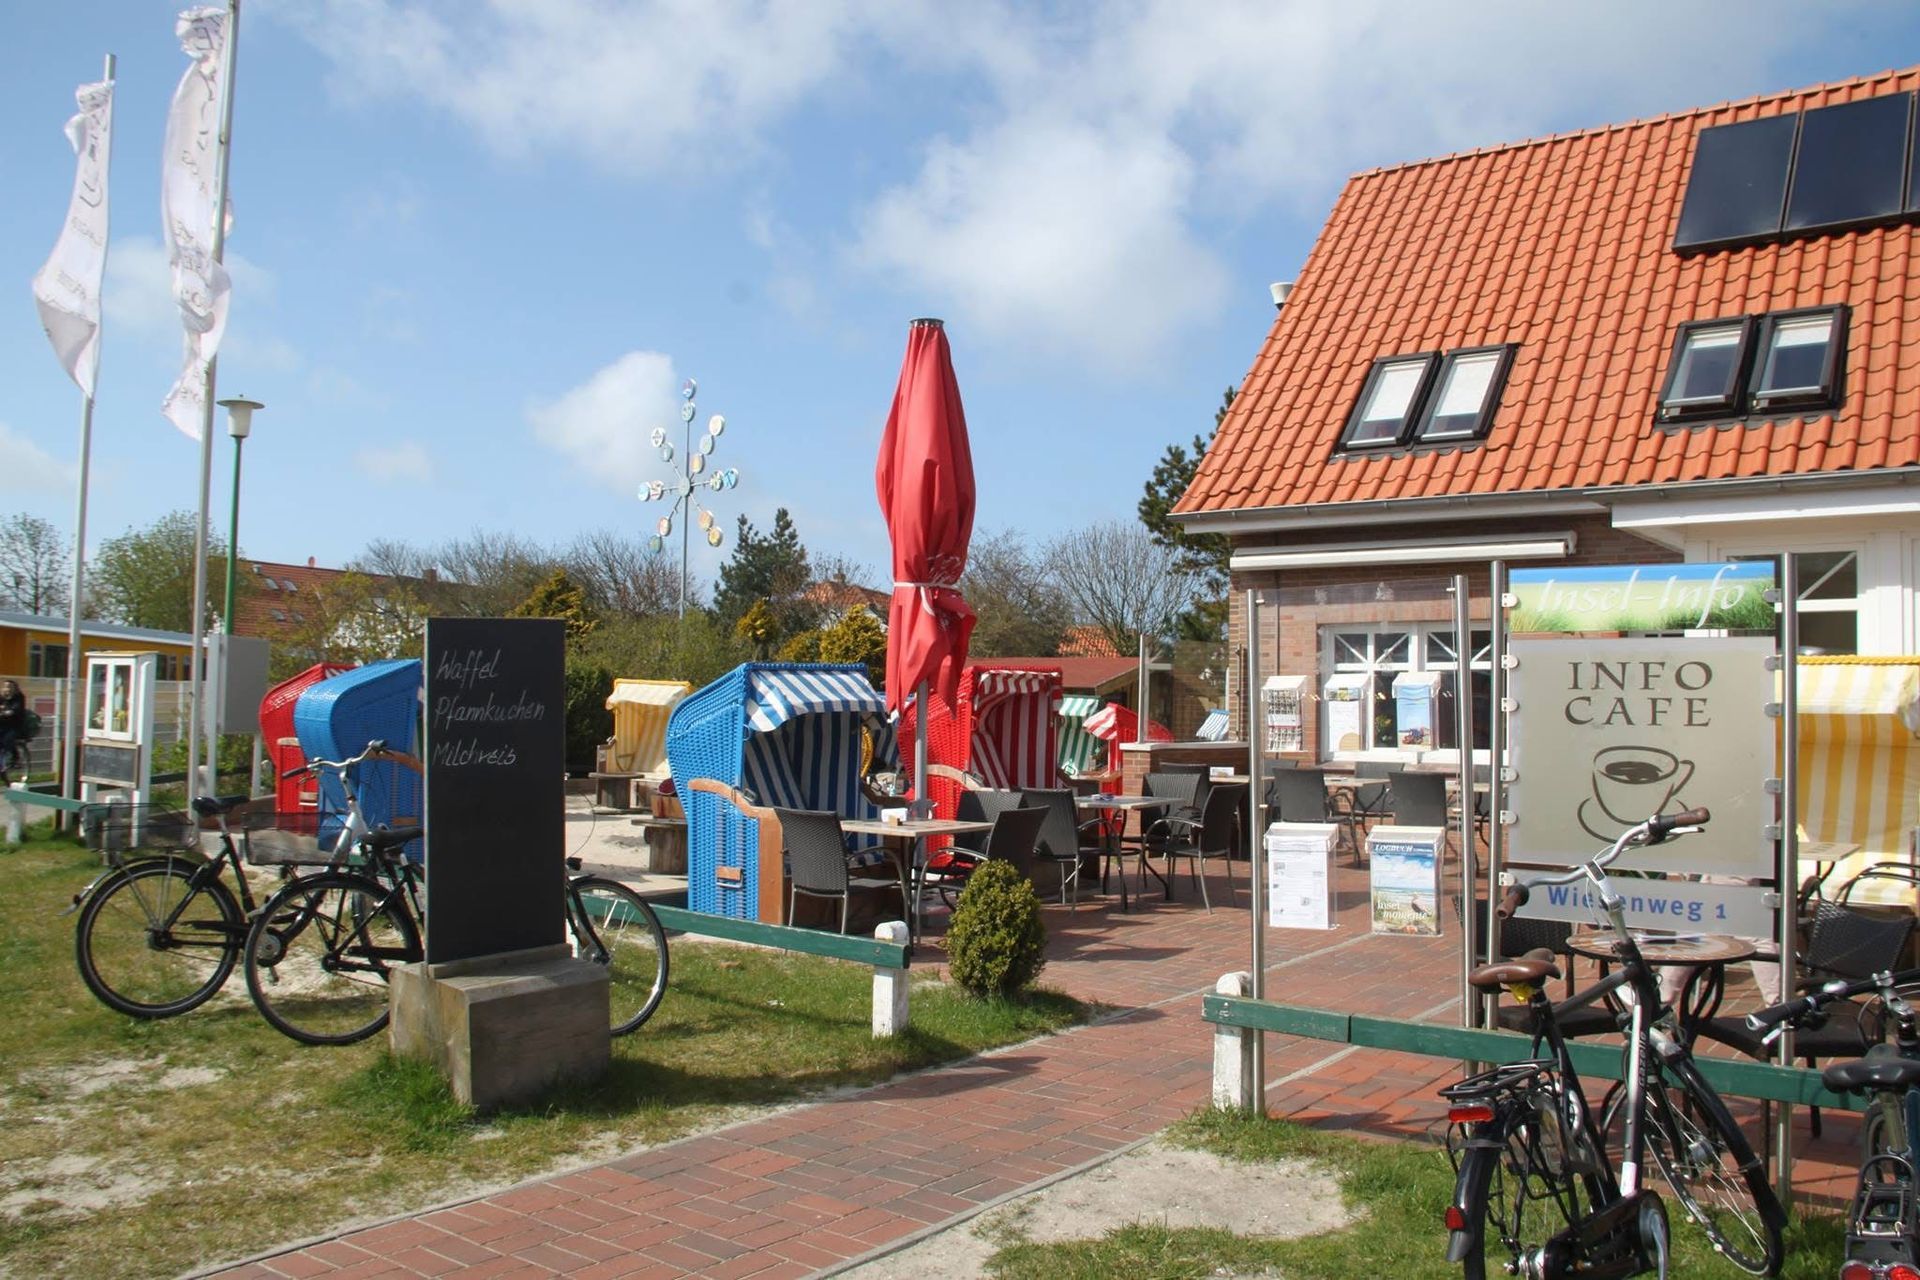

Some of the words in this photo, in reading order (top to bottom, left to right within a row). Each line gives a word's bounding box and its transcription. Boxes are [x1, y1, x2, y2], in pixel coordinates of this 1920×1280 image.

[1536, 563, 1746, 629] Insel-Info
[435, 648, 503, 689] Waffel
[1567, 661, 1713, 691] INFO
[1564, 695, 1713, 728] CAFE
[432, 738, 517, 767] Milchreis
[1715, 903, 1727, 920] 1
